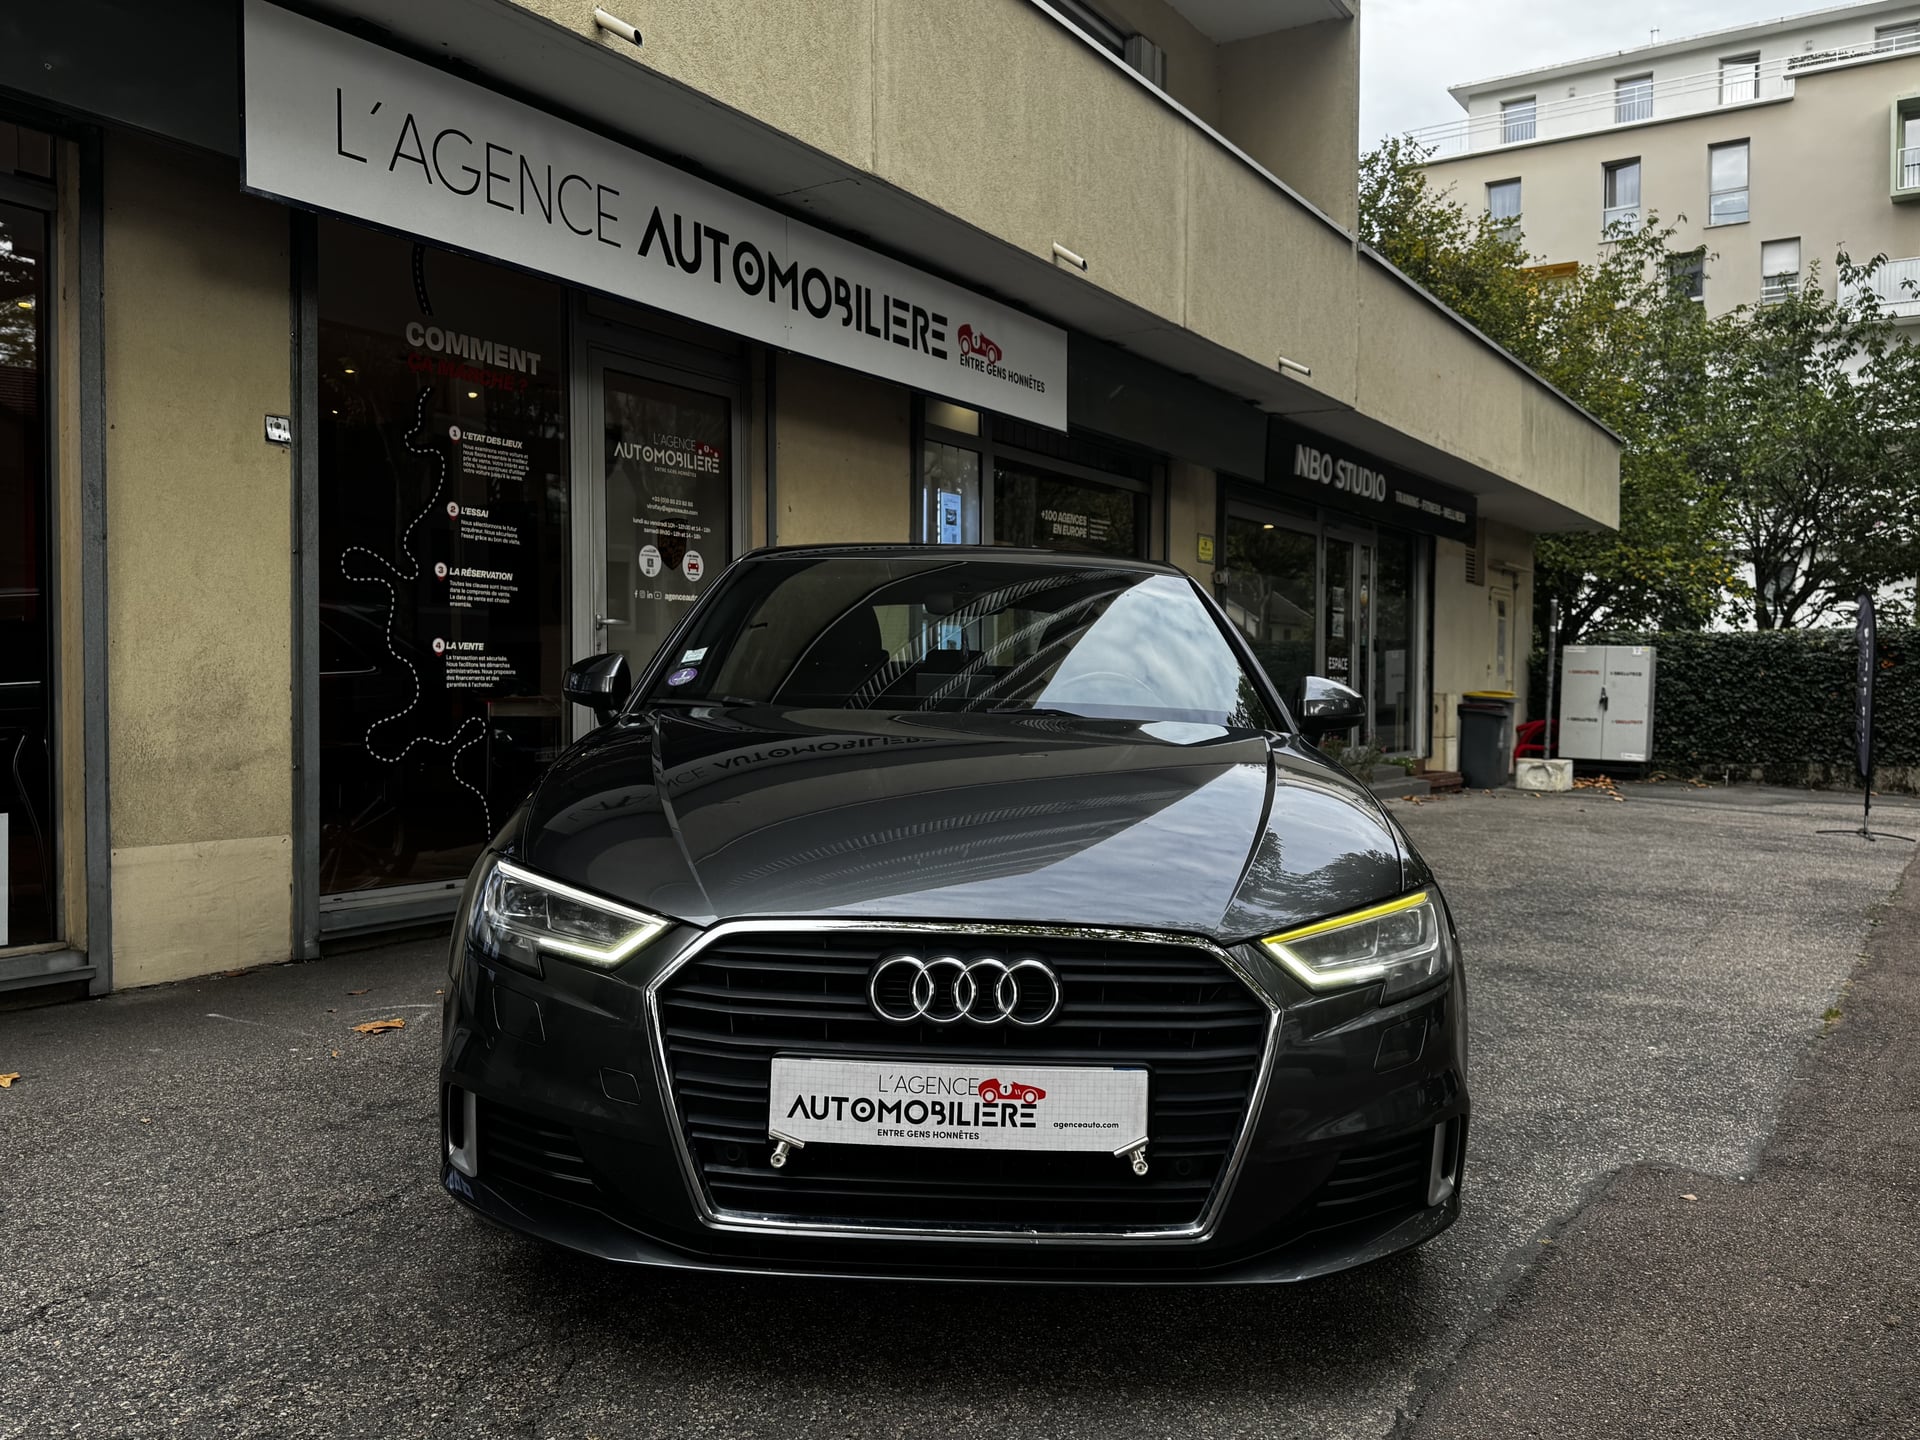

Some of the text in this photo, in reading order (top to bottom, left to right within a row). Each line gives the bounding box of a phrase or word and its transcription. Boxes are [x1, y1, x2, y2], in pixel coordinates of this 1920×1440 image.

[337, 88, 948, 360] L'AGENCE AUTOMOBILIERE
[406, 322, 541, 376] COMMENT
[961, 354, 1045, 393] ENTRE GENS HONNÊTES
[463, 432, 523, 449] L'ETAT DES LIEUX
[654, 432, 696, 451] L'AGENCE
[614, 442, 720, 474] AUTOMOBILIERE
[1294, 444, 1387, 502] NBO STUDIO
[461, 506, 489, 518] L'ESSAI
[1041, 510, 1057, 522] +100
[1058, 512, 1087, 526] AGENCES
[1053, 524, 1062, 535] EN
[1063, 525, 1087, 538] EUROPE
[450, 567, 513, 581] LA RÉSERVATION
[446, 642, 484, 651] LA VENTE
[1329, 657, 1348, 670] ESPACE
[880, 1074, 979, 1096] L'AGENCE
[787, 1095, 1037, 1129] AUTOMOBILIERE
[1054, 1120, 1119, 1130] agenceauto.com
[878, 1129, 979, 1140] ENTRE GENS HONNÊTES
